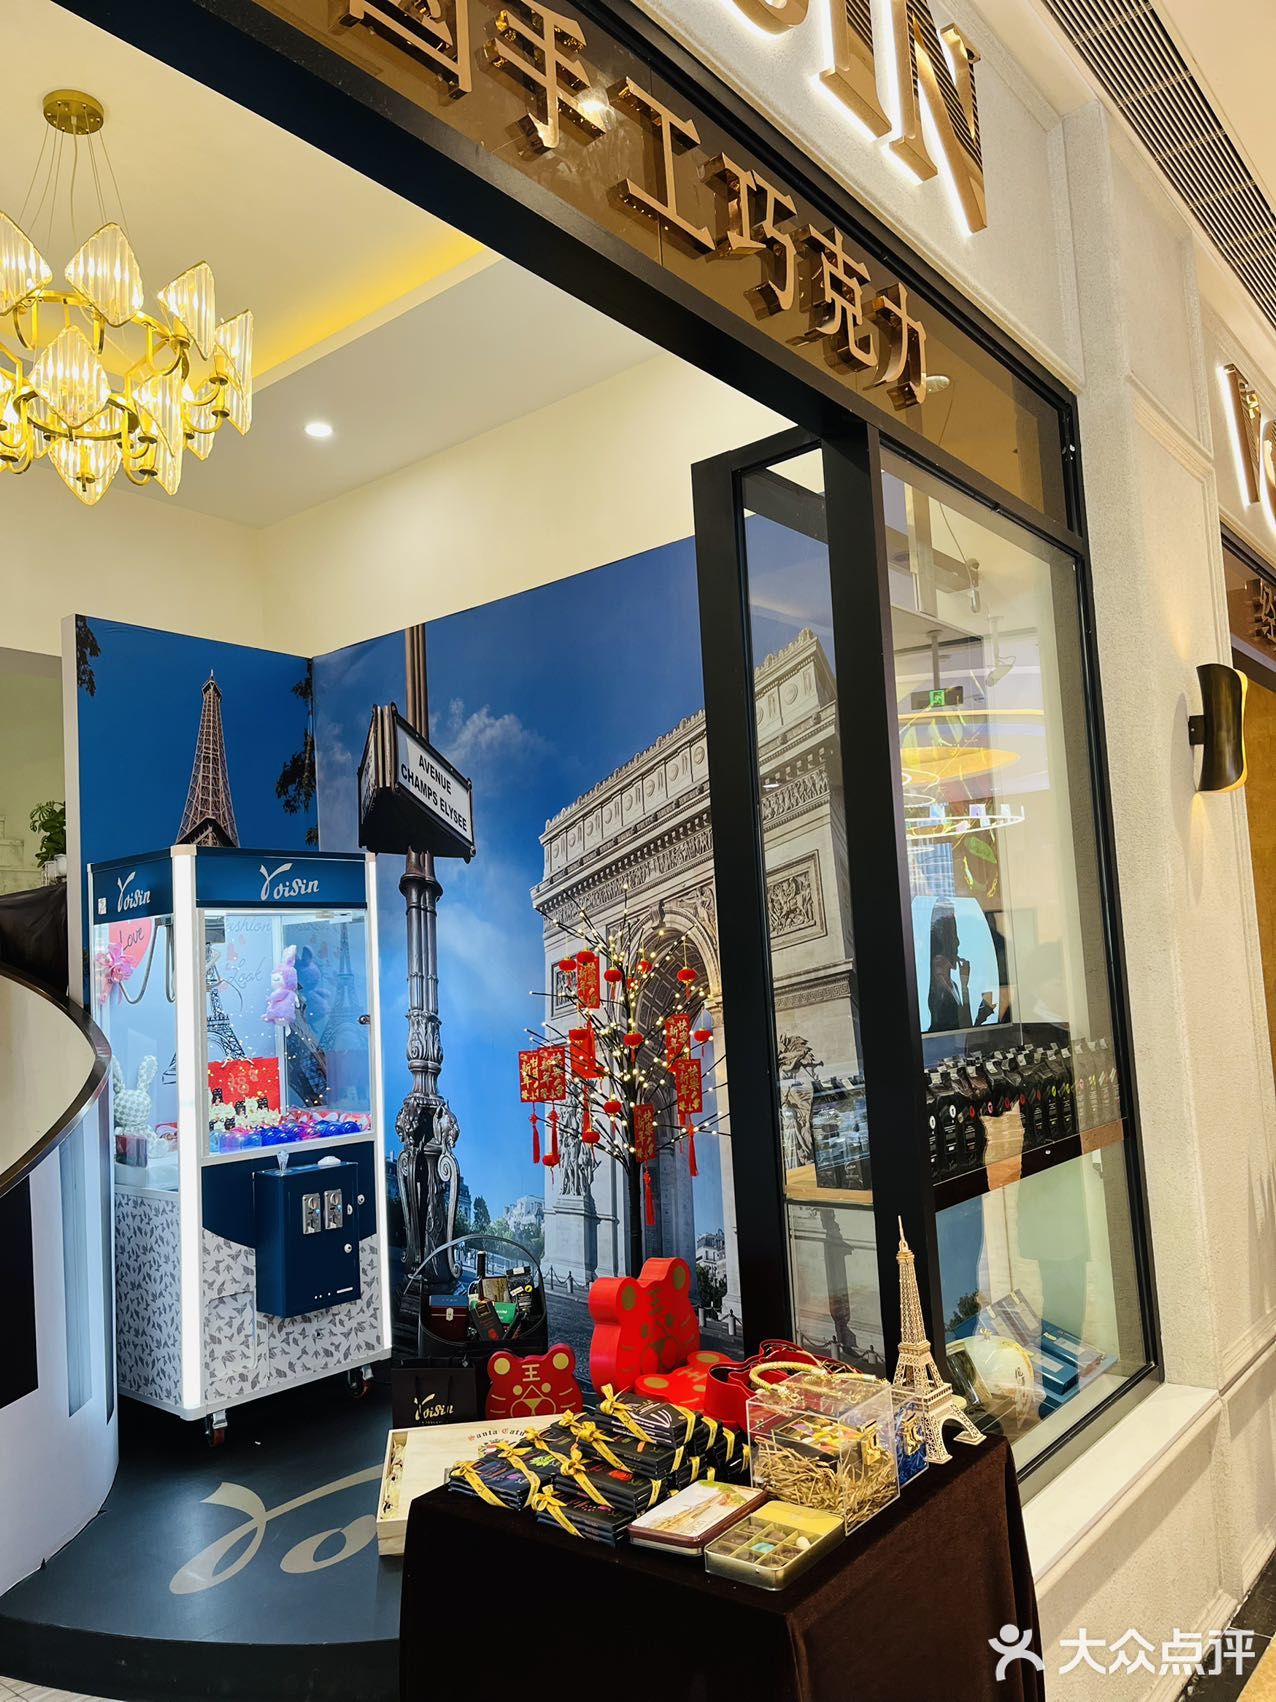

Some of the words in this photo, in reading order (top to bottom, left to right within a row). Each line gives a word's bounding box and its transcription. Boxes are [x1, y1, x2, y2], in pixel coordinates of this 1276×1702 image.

[418, 754, 452, 795] AVENUE
[400, 763, 438, 806] CHAMPS
[440, 797, 468, 832] ELYSEE
[116, 871, 151, 913] Voisin
[259, 862, 320, 901] Voisin
[522, 1363, 541, 1382] 王
[413, 1393, 454, 1421] Voisin
